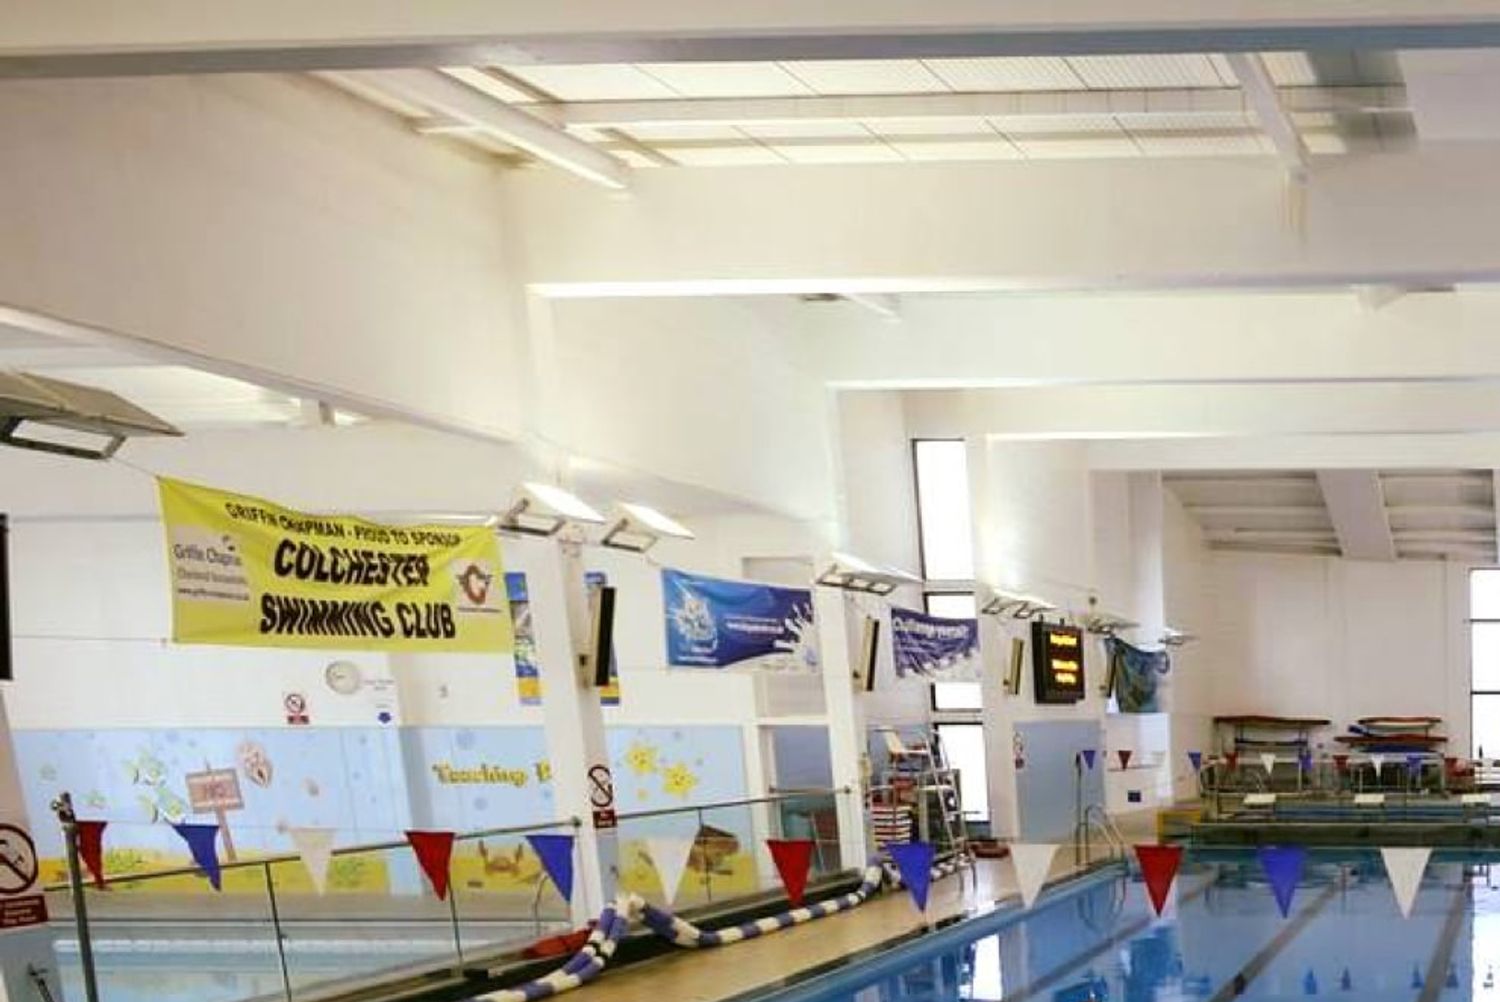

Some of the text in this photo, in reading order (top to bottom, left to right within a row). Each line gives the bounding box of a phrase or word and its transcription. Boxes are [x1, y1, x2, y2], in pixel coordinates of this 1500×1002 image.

[279, 515, 345, 538] CHAPMAN
[273, 538, 430, 586] COLCHESTER
[260, 592, 456, 639] SWIMMING CLUB
